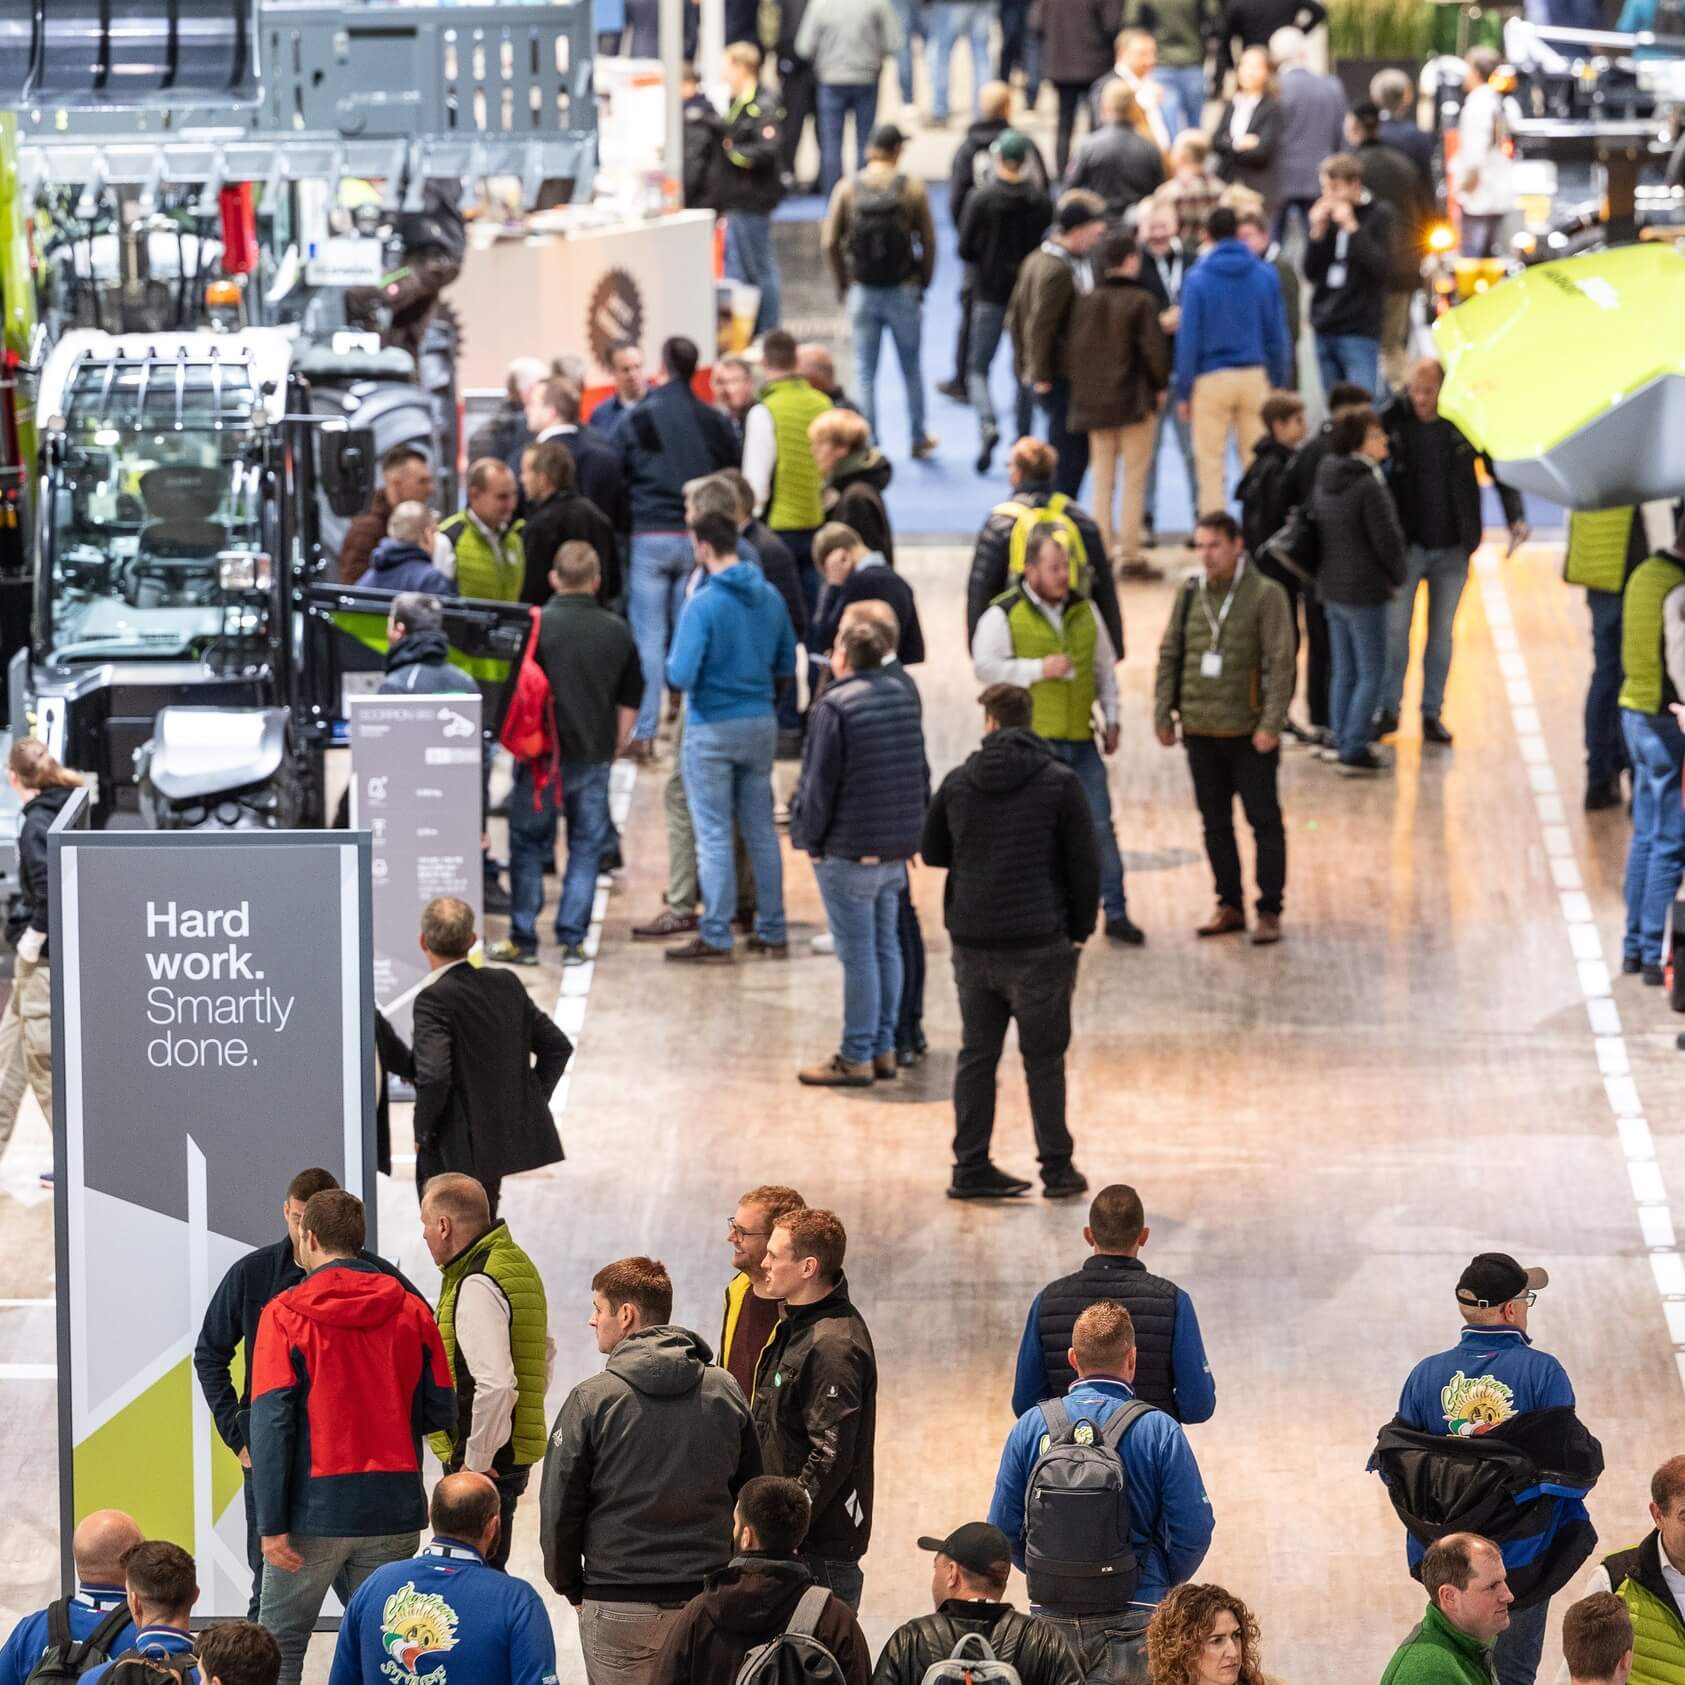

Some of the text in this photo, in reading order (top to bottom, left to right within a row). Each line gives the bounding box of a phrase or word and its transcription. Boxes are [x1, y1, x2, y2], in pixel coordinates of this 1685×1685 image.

[146, 900, 250, 938] Hard
[144, 943, 265, 980] work.
[146, 986, 295, 1032] Smartly
[147, 1029, 258, 1067] done.
